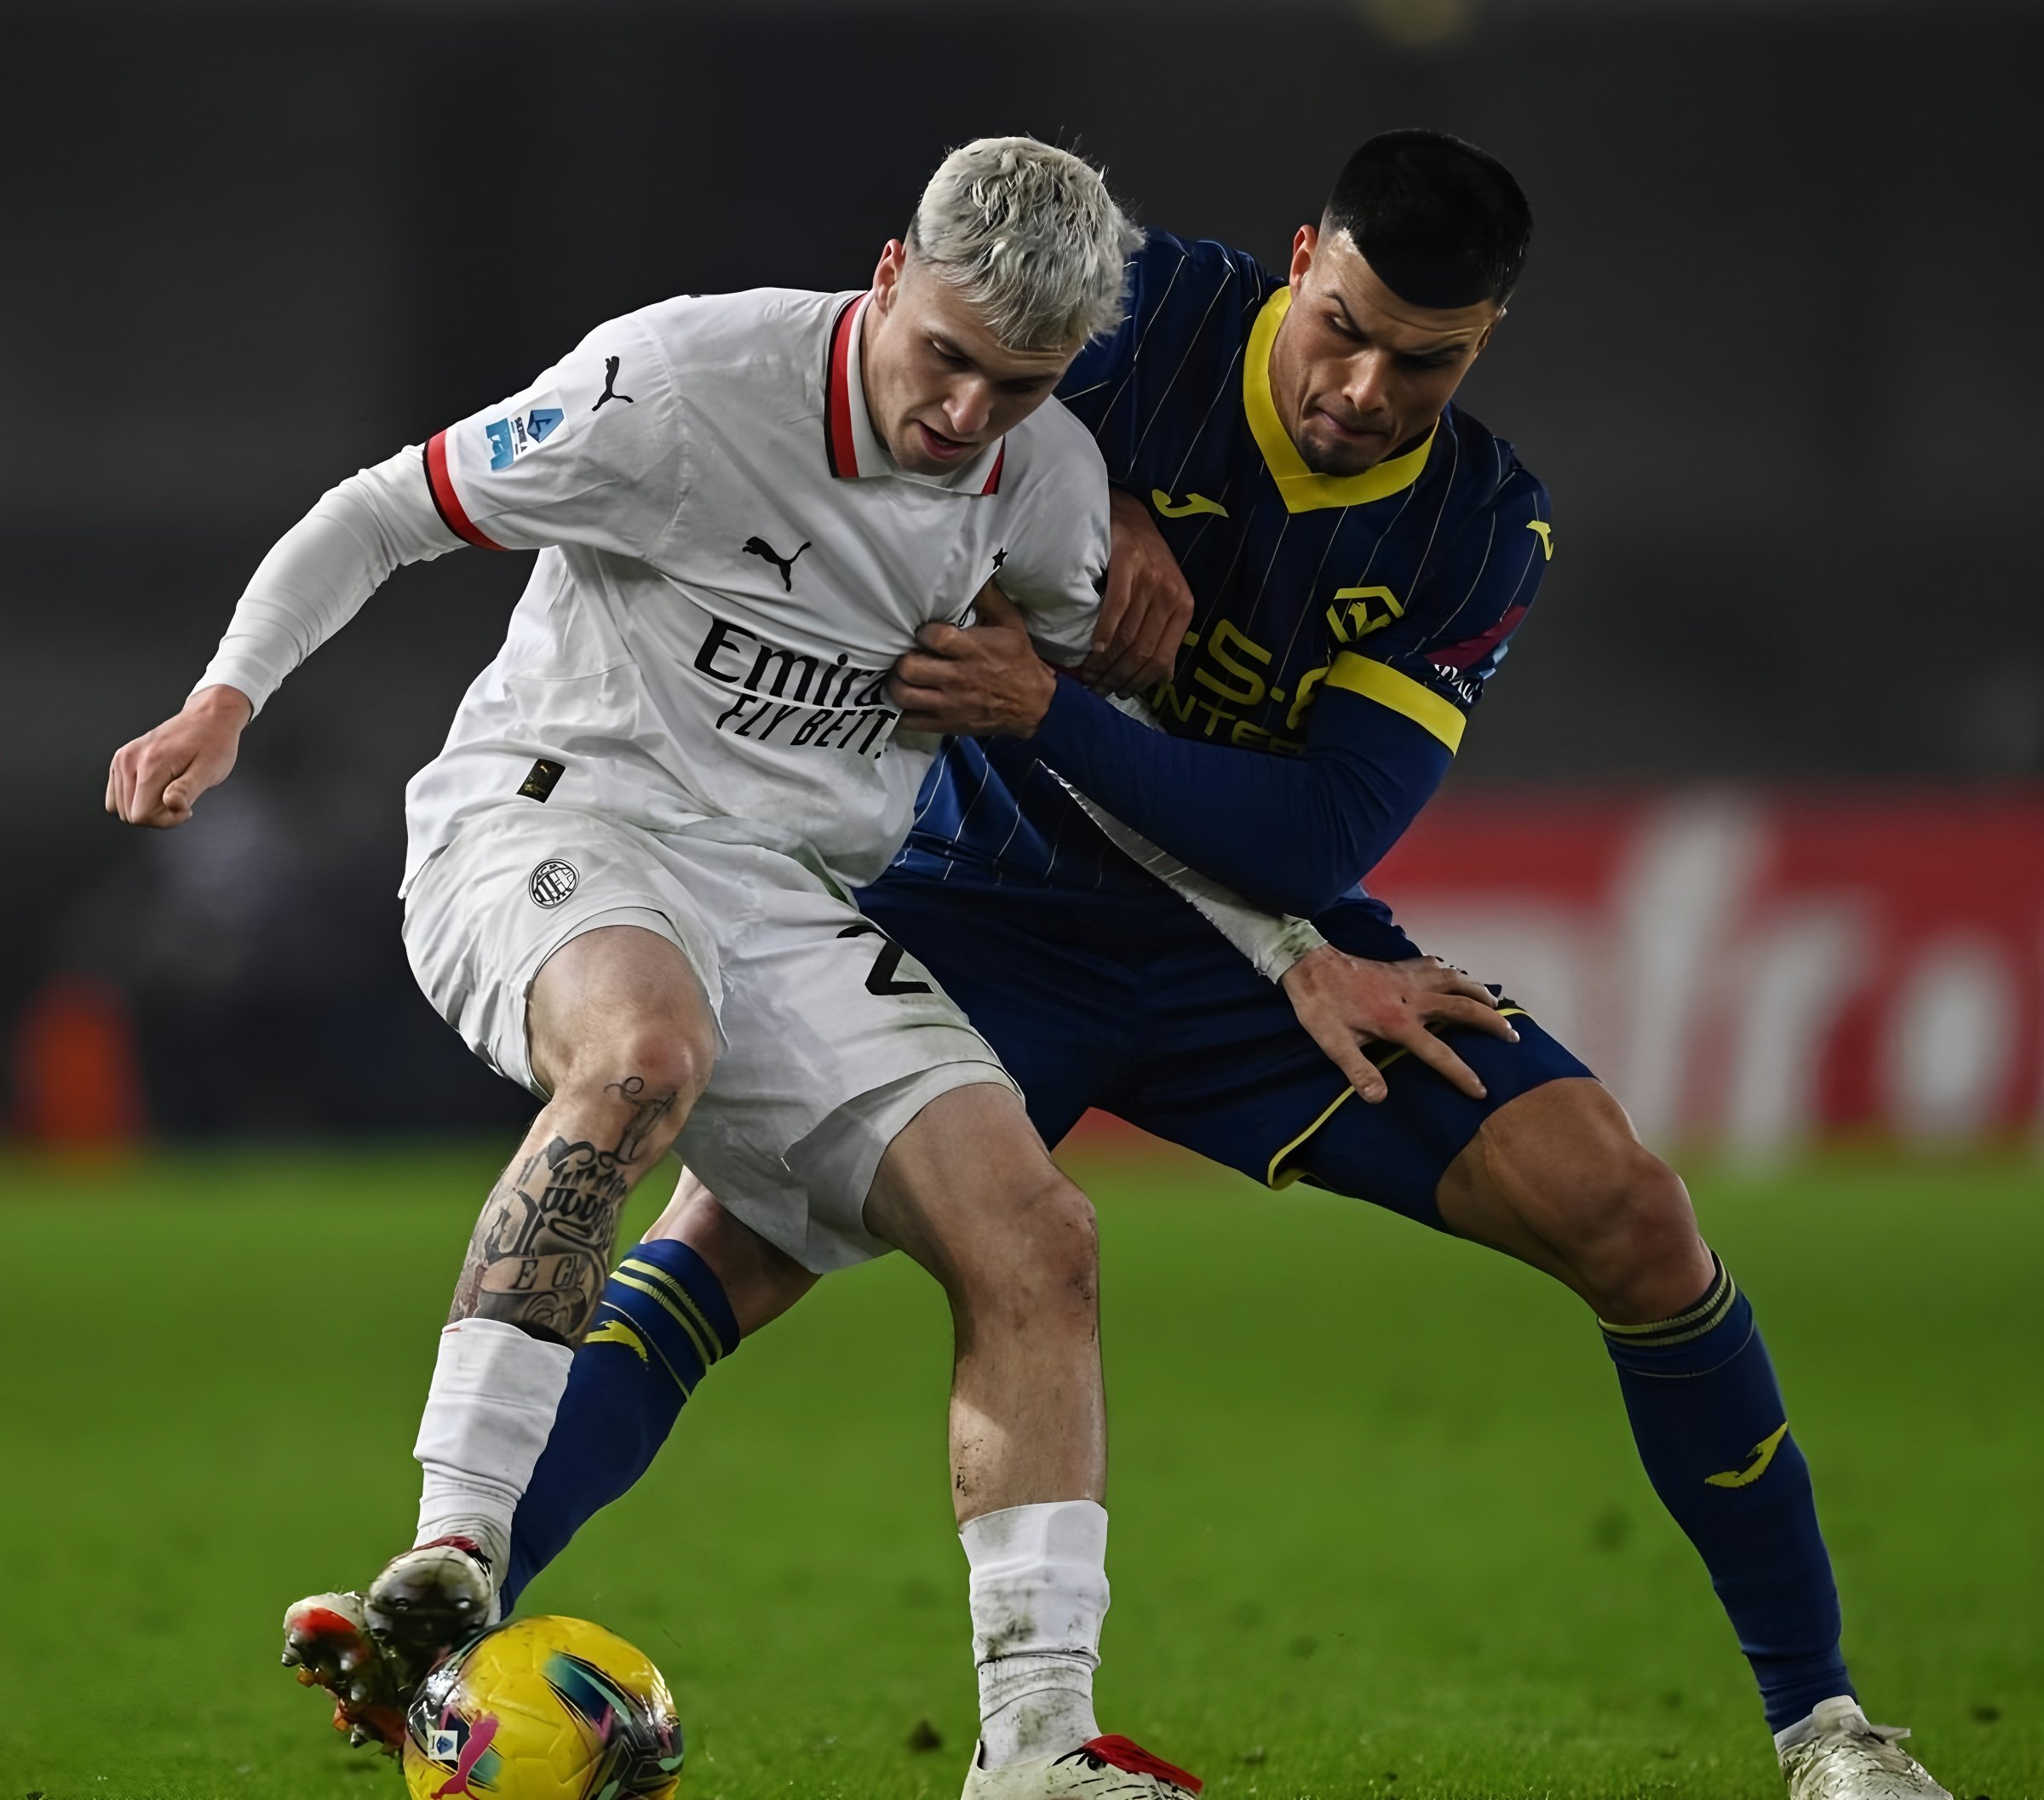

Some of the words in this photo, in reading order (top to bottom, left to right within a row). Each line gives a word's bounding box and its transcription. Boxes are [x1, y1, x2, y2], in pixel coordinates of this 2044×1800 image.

[715, 693, 798, 742] FLY
[790, 708, 899, 760] BETT
[836, 925, 935, 996] 2
